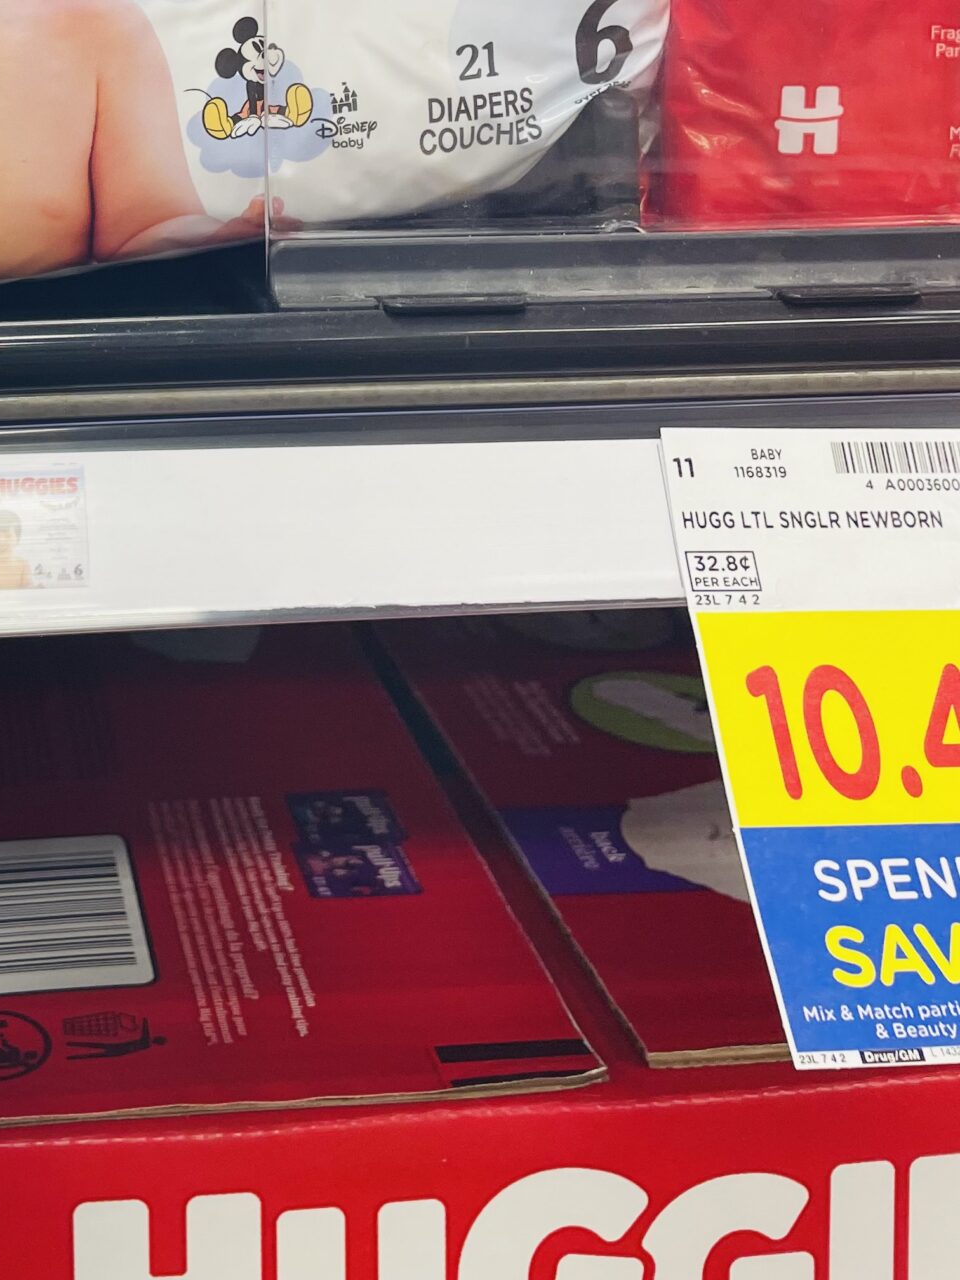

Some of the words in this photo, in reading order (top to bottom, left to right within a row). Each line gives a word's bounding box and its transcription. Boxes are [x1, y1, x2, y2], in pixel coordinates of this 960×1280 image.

[455, 41, 500, 82] 21
[428, 86, 533, 125] DIAPERS
[332, 136, 364, 150] baby
[419, 114, 543, 157] COUCHES
[673, 457, 695, 478] 11
[751, 448, 782, 460] BABY
[734, 466, 787, 478] 1168319
[682, 511, 735, 529] HUGG
[741, 511, 774, 529] LTL
[780, 511, 841, 529] SNGLR
[847, 510, 944, 528] NEWBORN
[694, 555, 751, 572] 32.8¢
[695, 576, 719, 588] PER
[723, 576, 758, 588] EACH
[695, 594, 720, 606] 23L
[813, 856, 960, 902] SPEN
[803, 1005, 836, 1023] Mix
[841, 1004, 854, 1020] &
[857, 1002, 913, 1020] Match
[876, 1023, 889, 1039] &
[893, 1020, 957, 1039] Beauty
